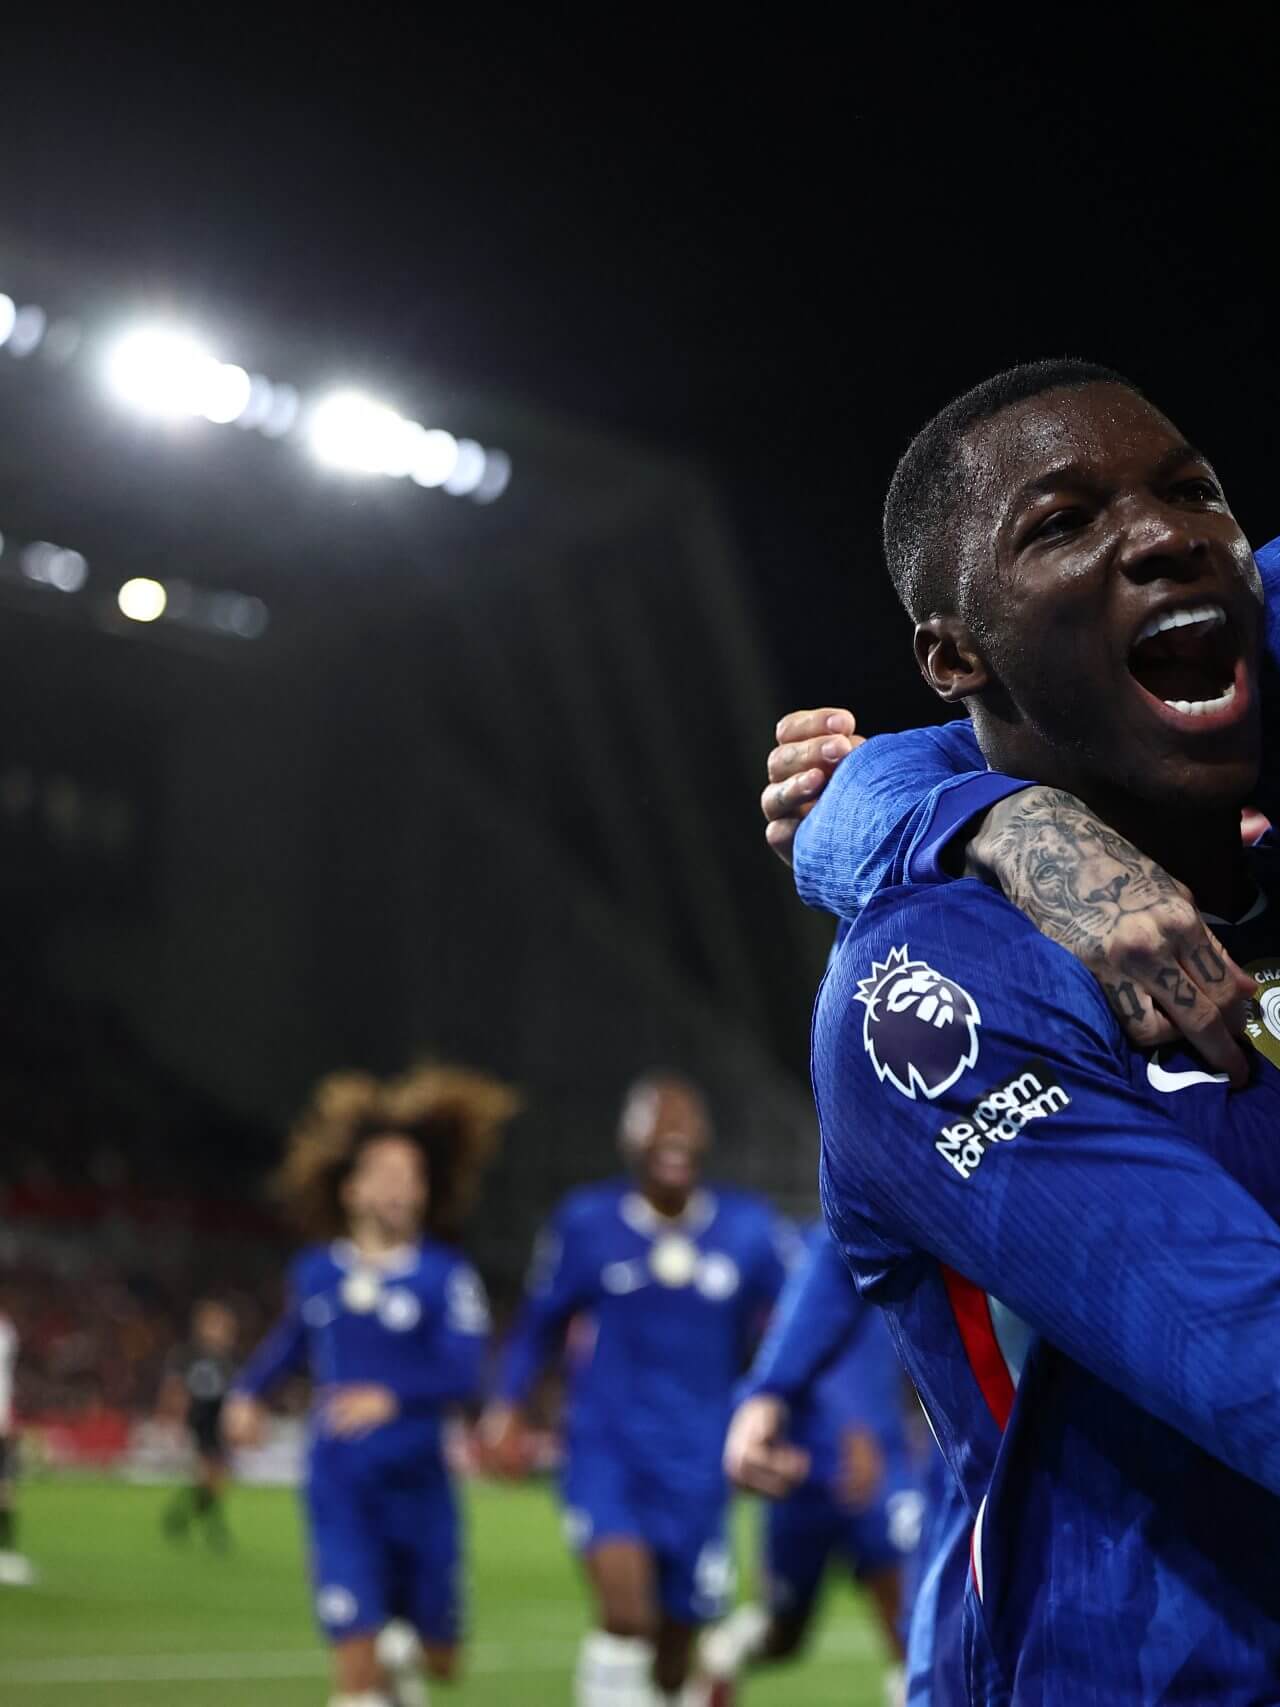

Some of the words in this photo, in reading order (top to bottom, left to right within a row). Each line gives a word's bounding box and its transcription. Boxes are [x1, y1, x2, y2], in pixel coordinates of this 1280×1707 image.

[935, 1123, 975, 1164] No
[973, 1072, 1042, 1131] room
[952, 1134, 985, 1178] for
